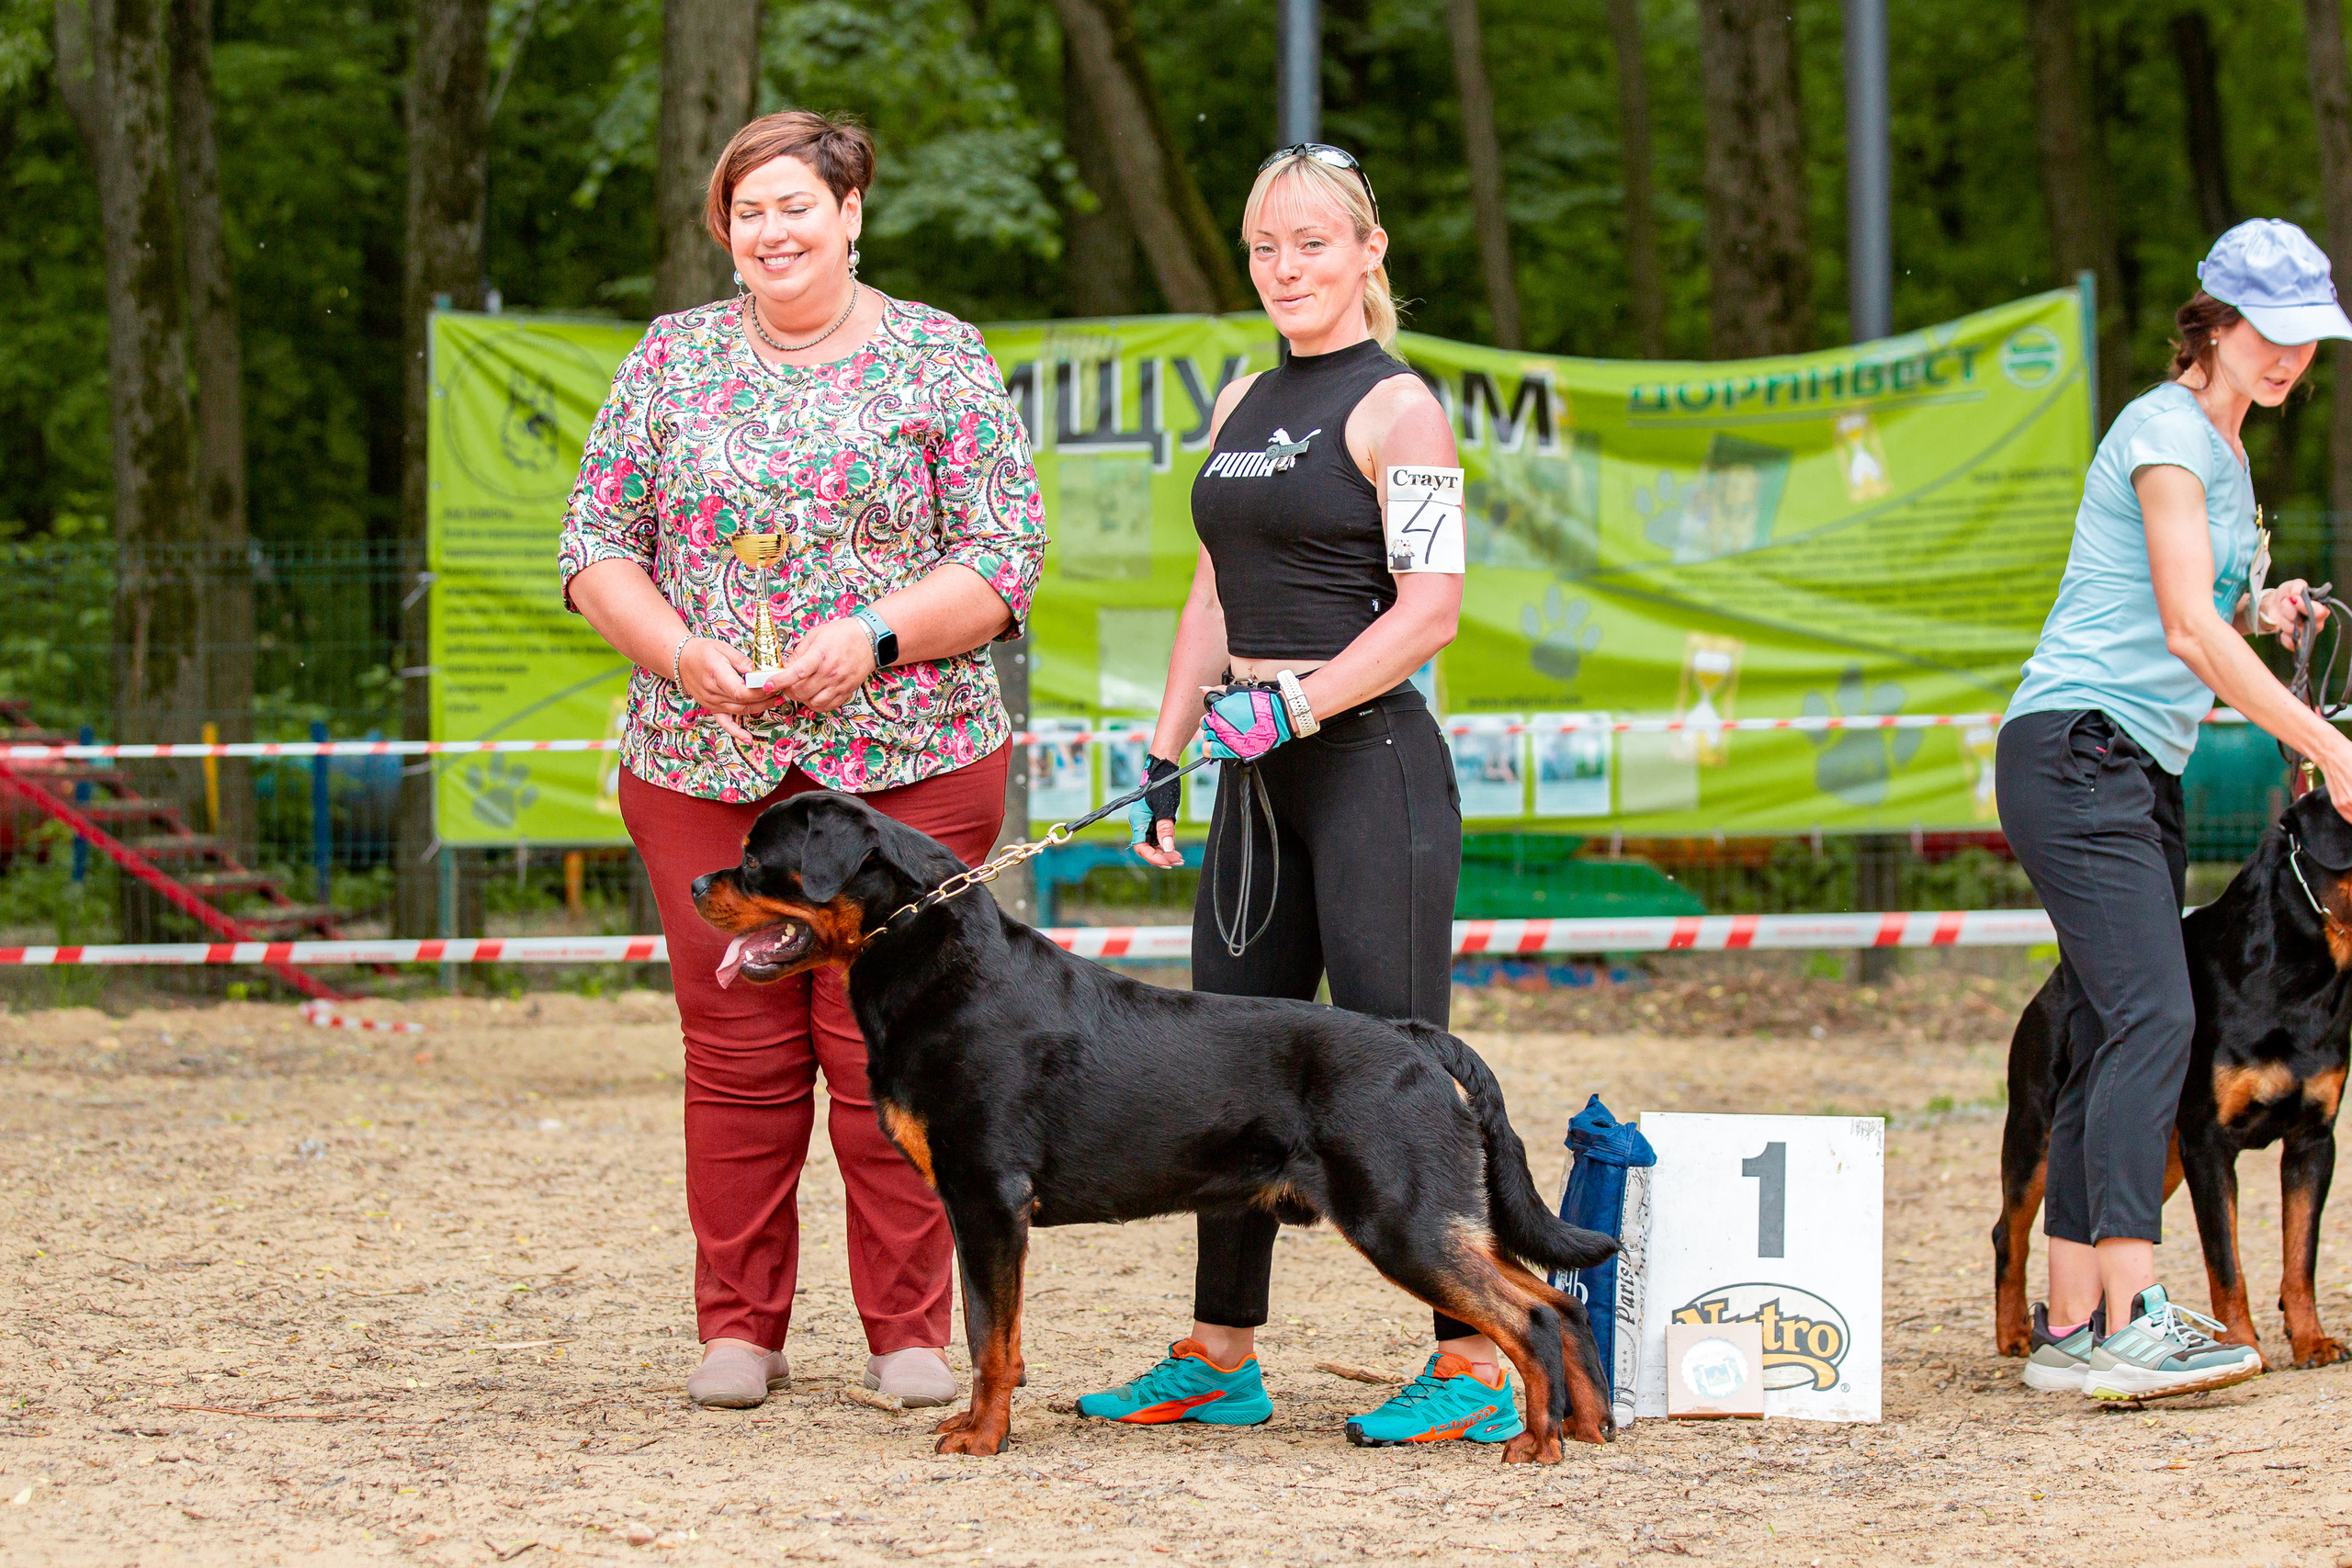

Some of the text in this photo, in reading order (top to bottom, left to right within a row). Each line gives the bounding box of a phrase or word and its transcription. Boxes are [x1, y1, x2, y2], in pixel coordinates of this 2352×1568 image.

[1204, 451, 1277, 478] PUMA
[1392, 468, 1458, 491] Стаут
[1401, 491, 1447, 565] 4
[1741, 1141, 1787, 1258] 1
